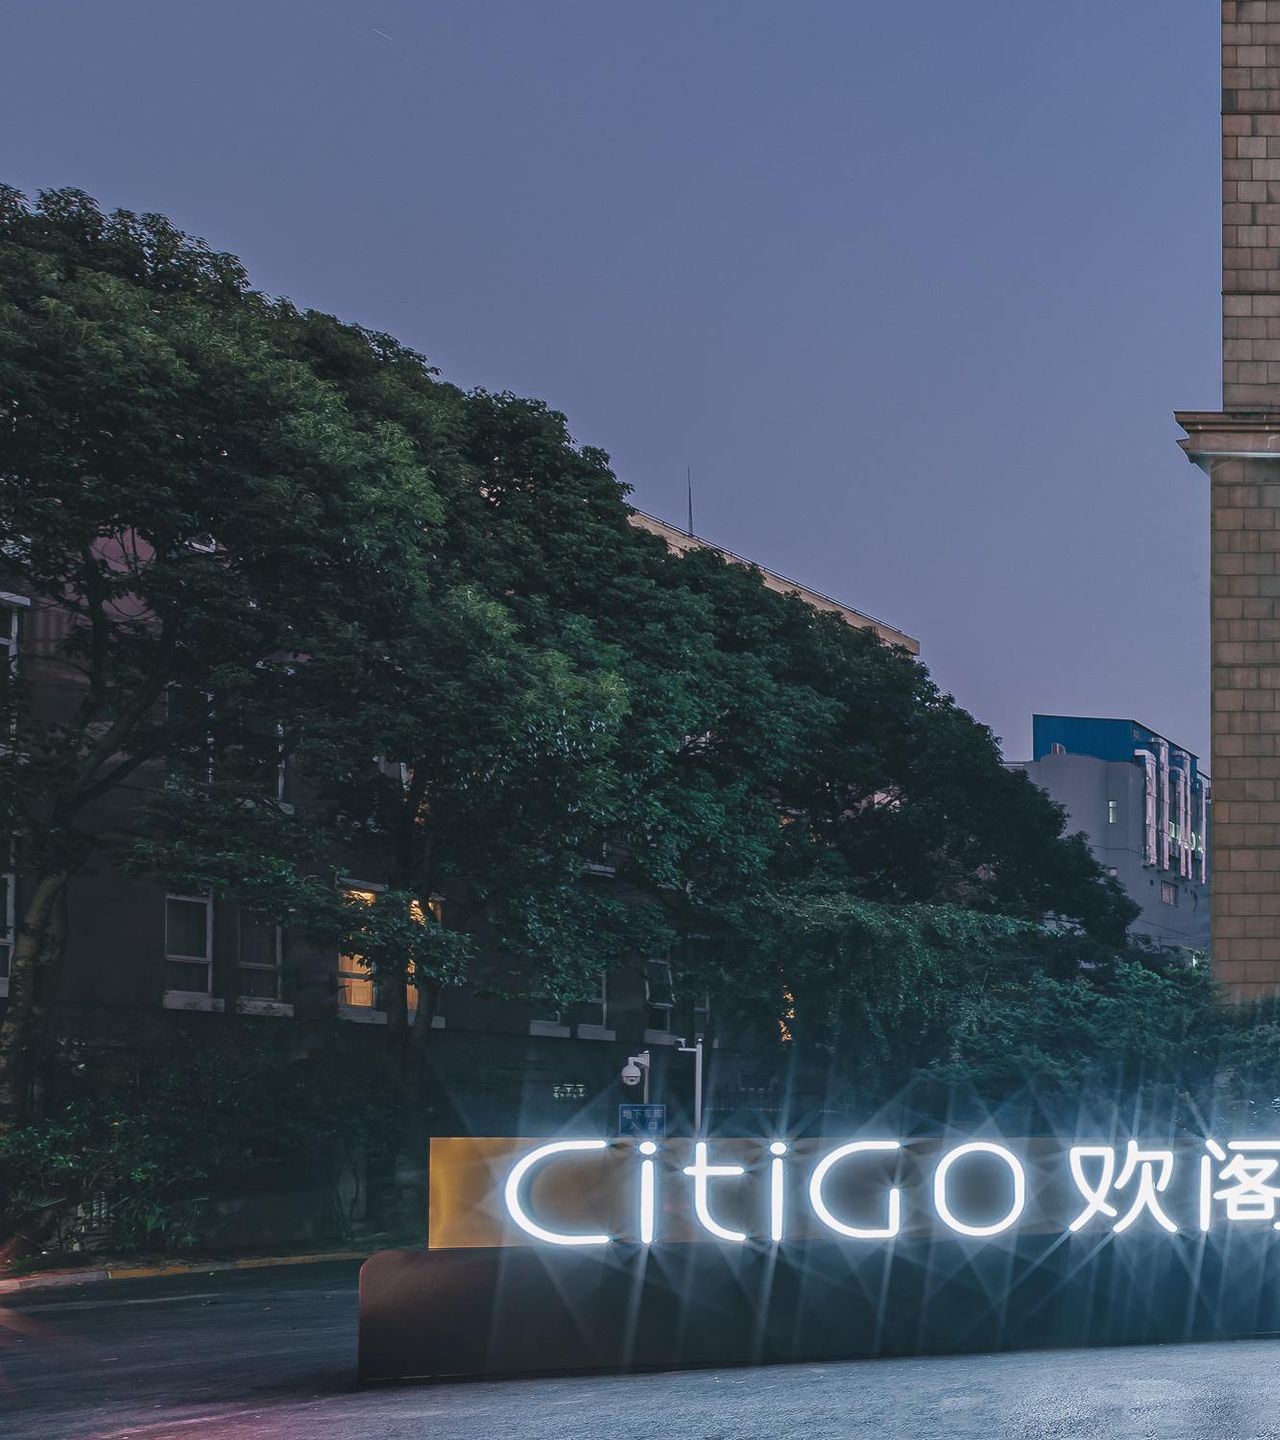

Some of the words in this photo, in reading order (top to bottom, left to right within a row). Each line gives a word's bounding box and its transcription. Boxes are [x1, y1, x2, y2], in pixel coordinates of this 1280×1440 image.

[622, 1108, 663, 1120] 地下车库
[503, 1138, 1026, 1245] CitiGO
